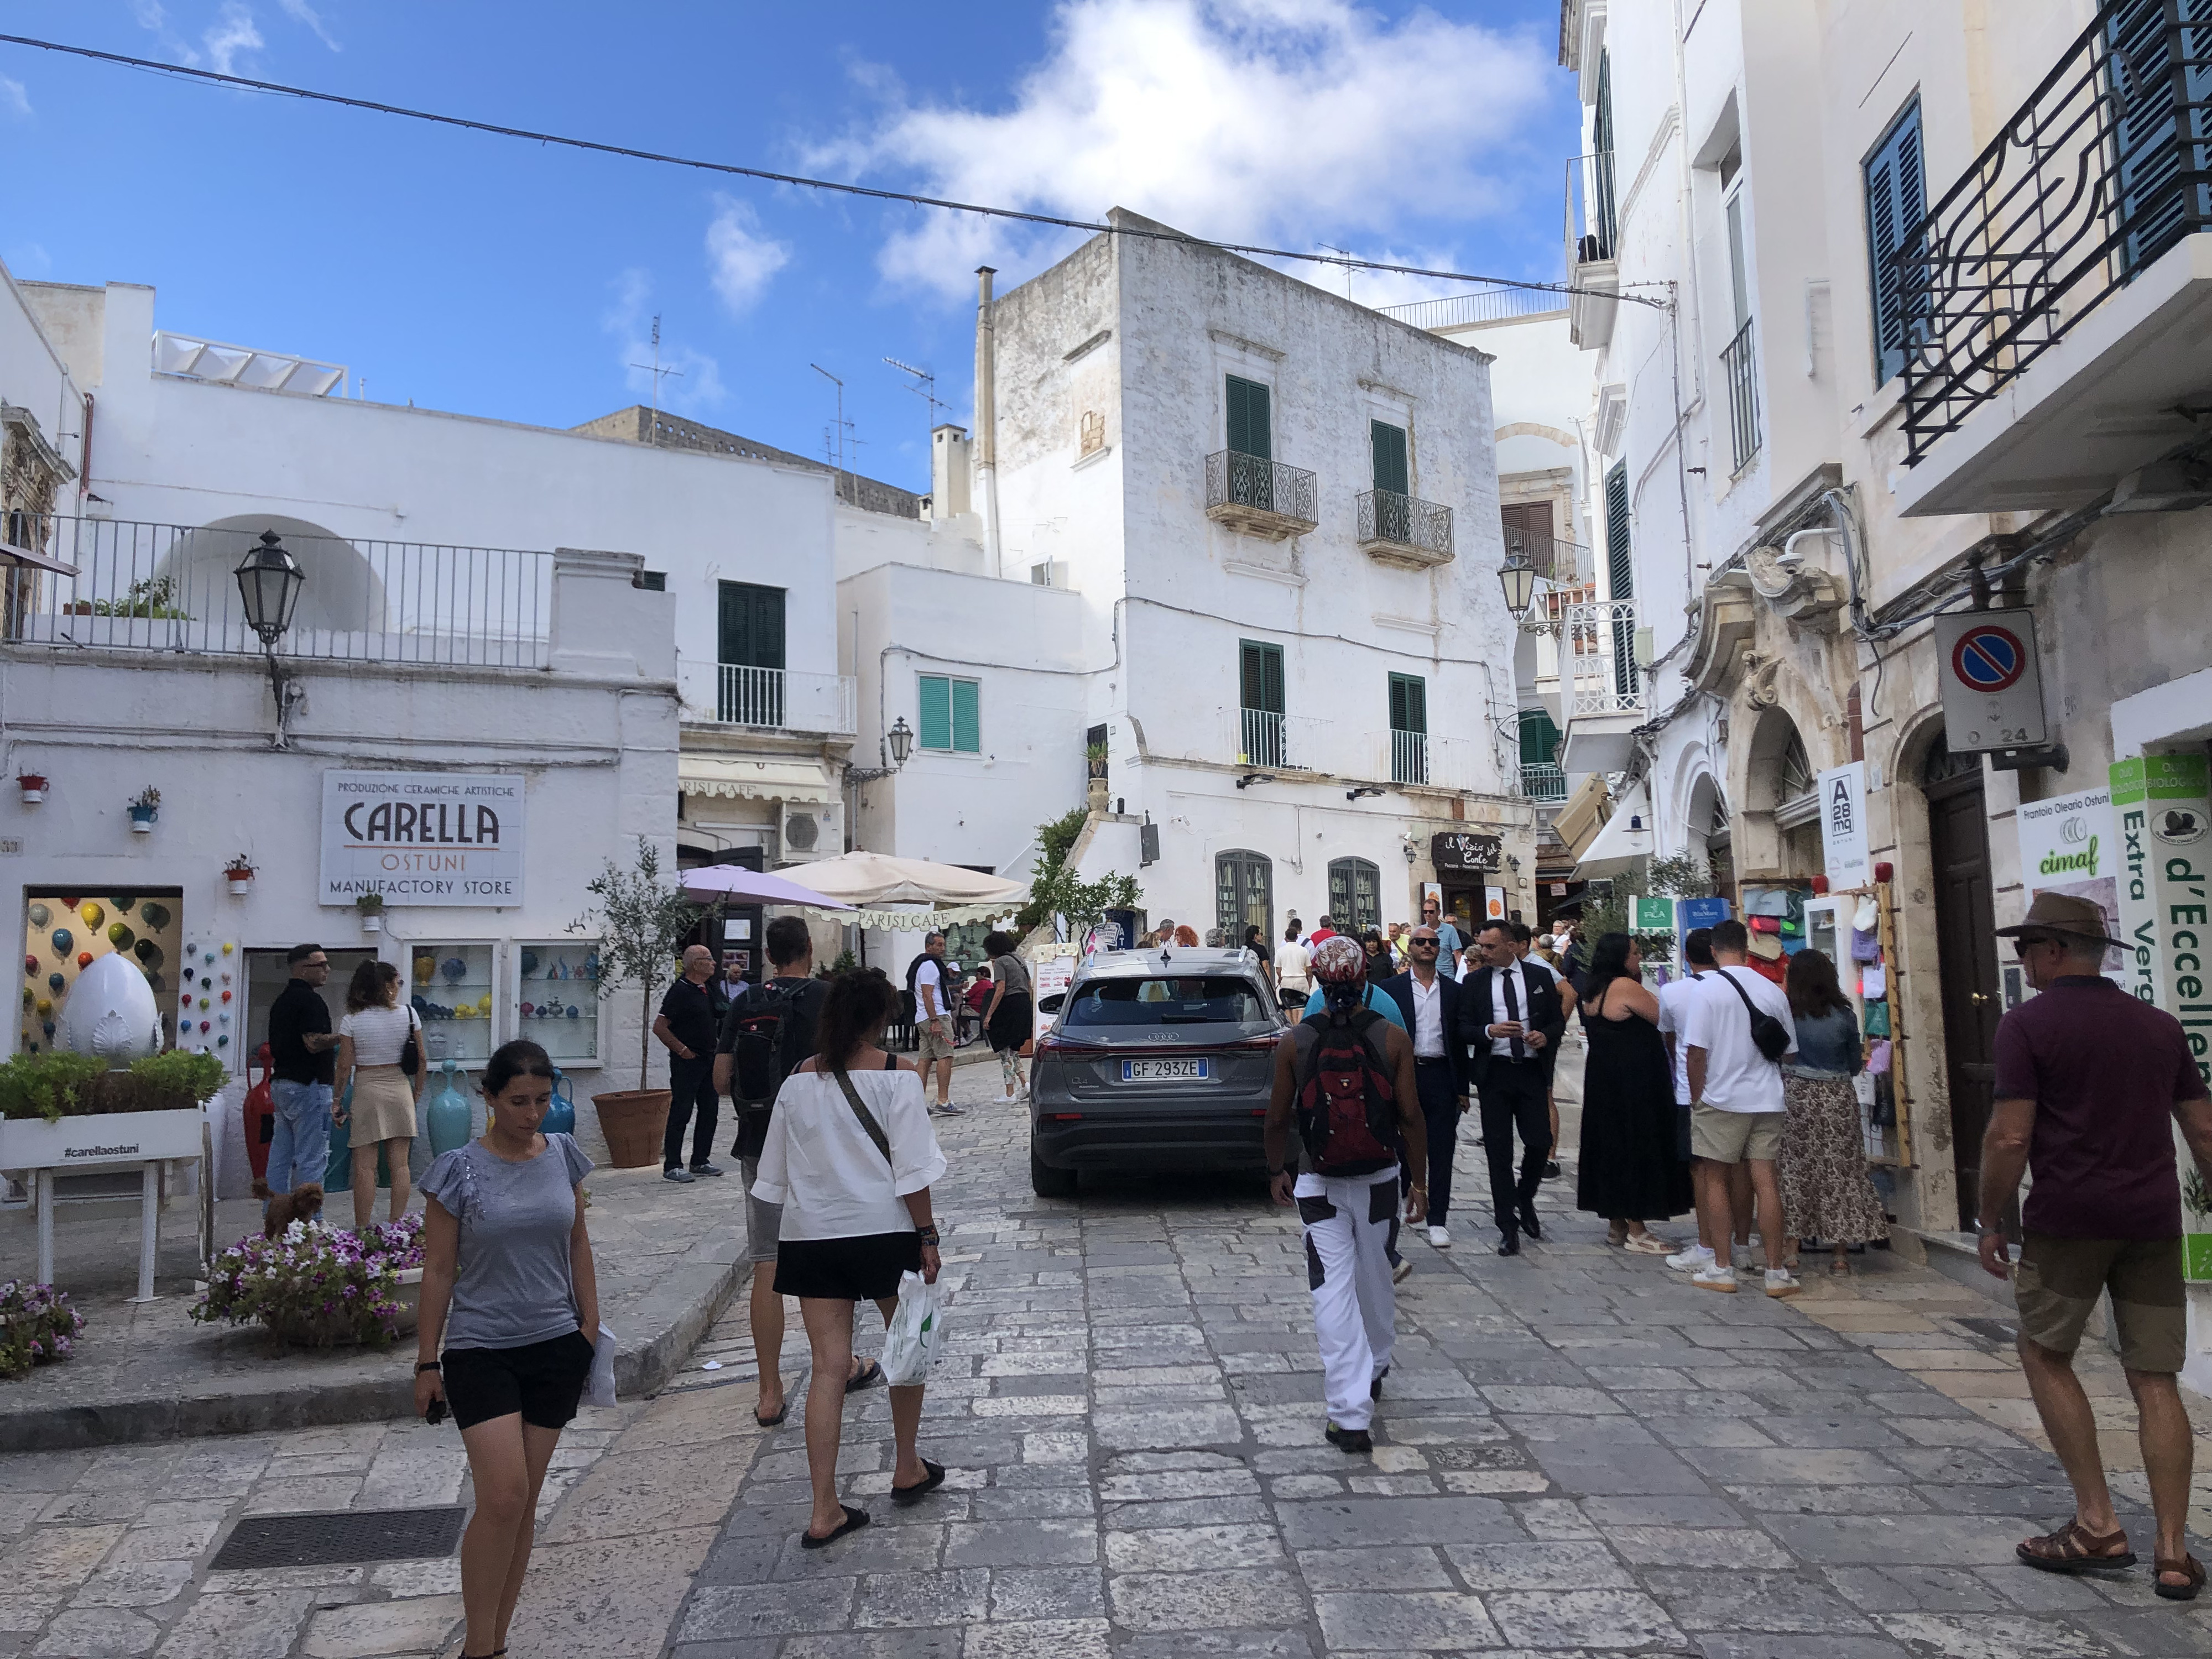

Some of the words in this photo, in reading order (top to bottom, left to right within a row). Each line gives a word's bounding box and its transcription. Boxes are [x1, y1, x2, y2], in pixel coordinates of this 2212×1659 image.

[2000, 727, 2028, 742] 24
[337, 782, 400, 794] PRODUZIONE
[404, 784, 460, 796] CERAMICHE
[464, 786, 515, 797] ARTISTICHE
[1833, 780, 1849, 804] A
[1833, 802, 1851, 821] 28
[2023, 806, 2053, 820] Frantoio
[2054, 799, 2083, 813] Oleario
[2084, 792, 2110, 807] Ostuni
[343, 801, 500, 843] CARELLA
[1833, 818, 1853, 832] mq
[1456, 836, 1484, 852] Vizio
[380, 853, 466, 872] OSTUNI
[1463, 851, 1488, 864] Conte
[2039, 835, 2100, 877] cimaf
[2124, 810, 2146, 901] Extra
[329, 879, 453, 895] MANUFACTORY
[464, 880, 512, 895] STORE
[858, 912, 905, 927] PARISI
[2133, 919, 2156, 1005] Verg
[1133, 1062, 1149, 1076] GF
[1155, 1061, 1198, 1076] 293ZE
[64, 1143, 139, 1158] #carellaostuni
